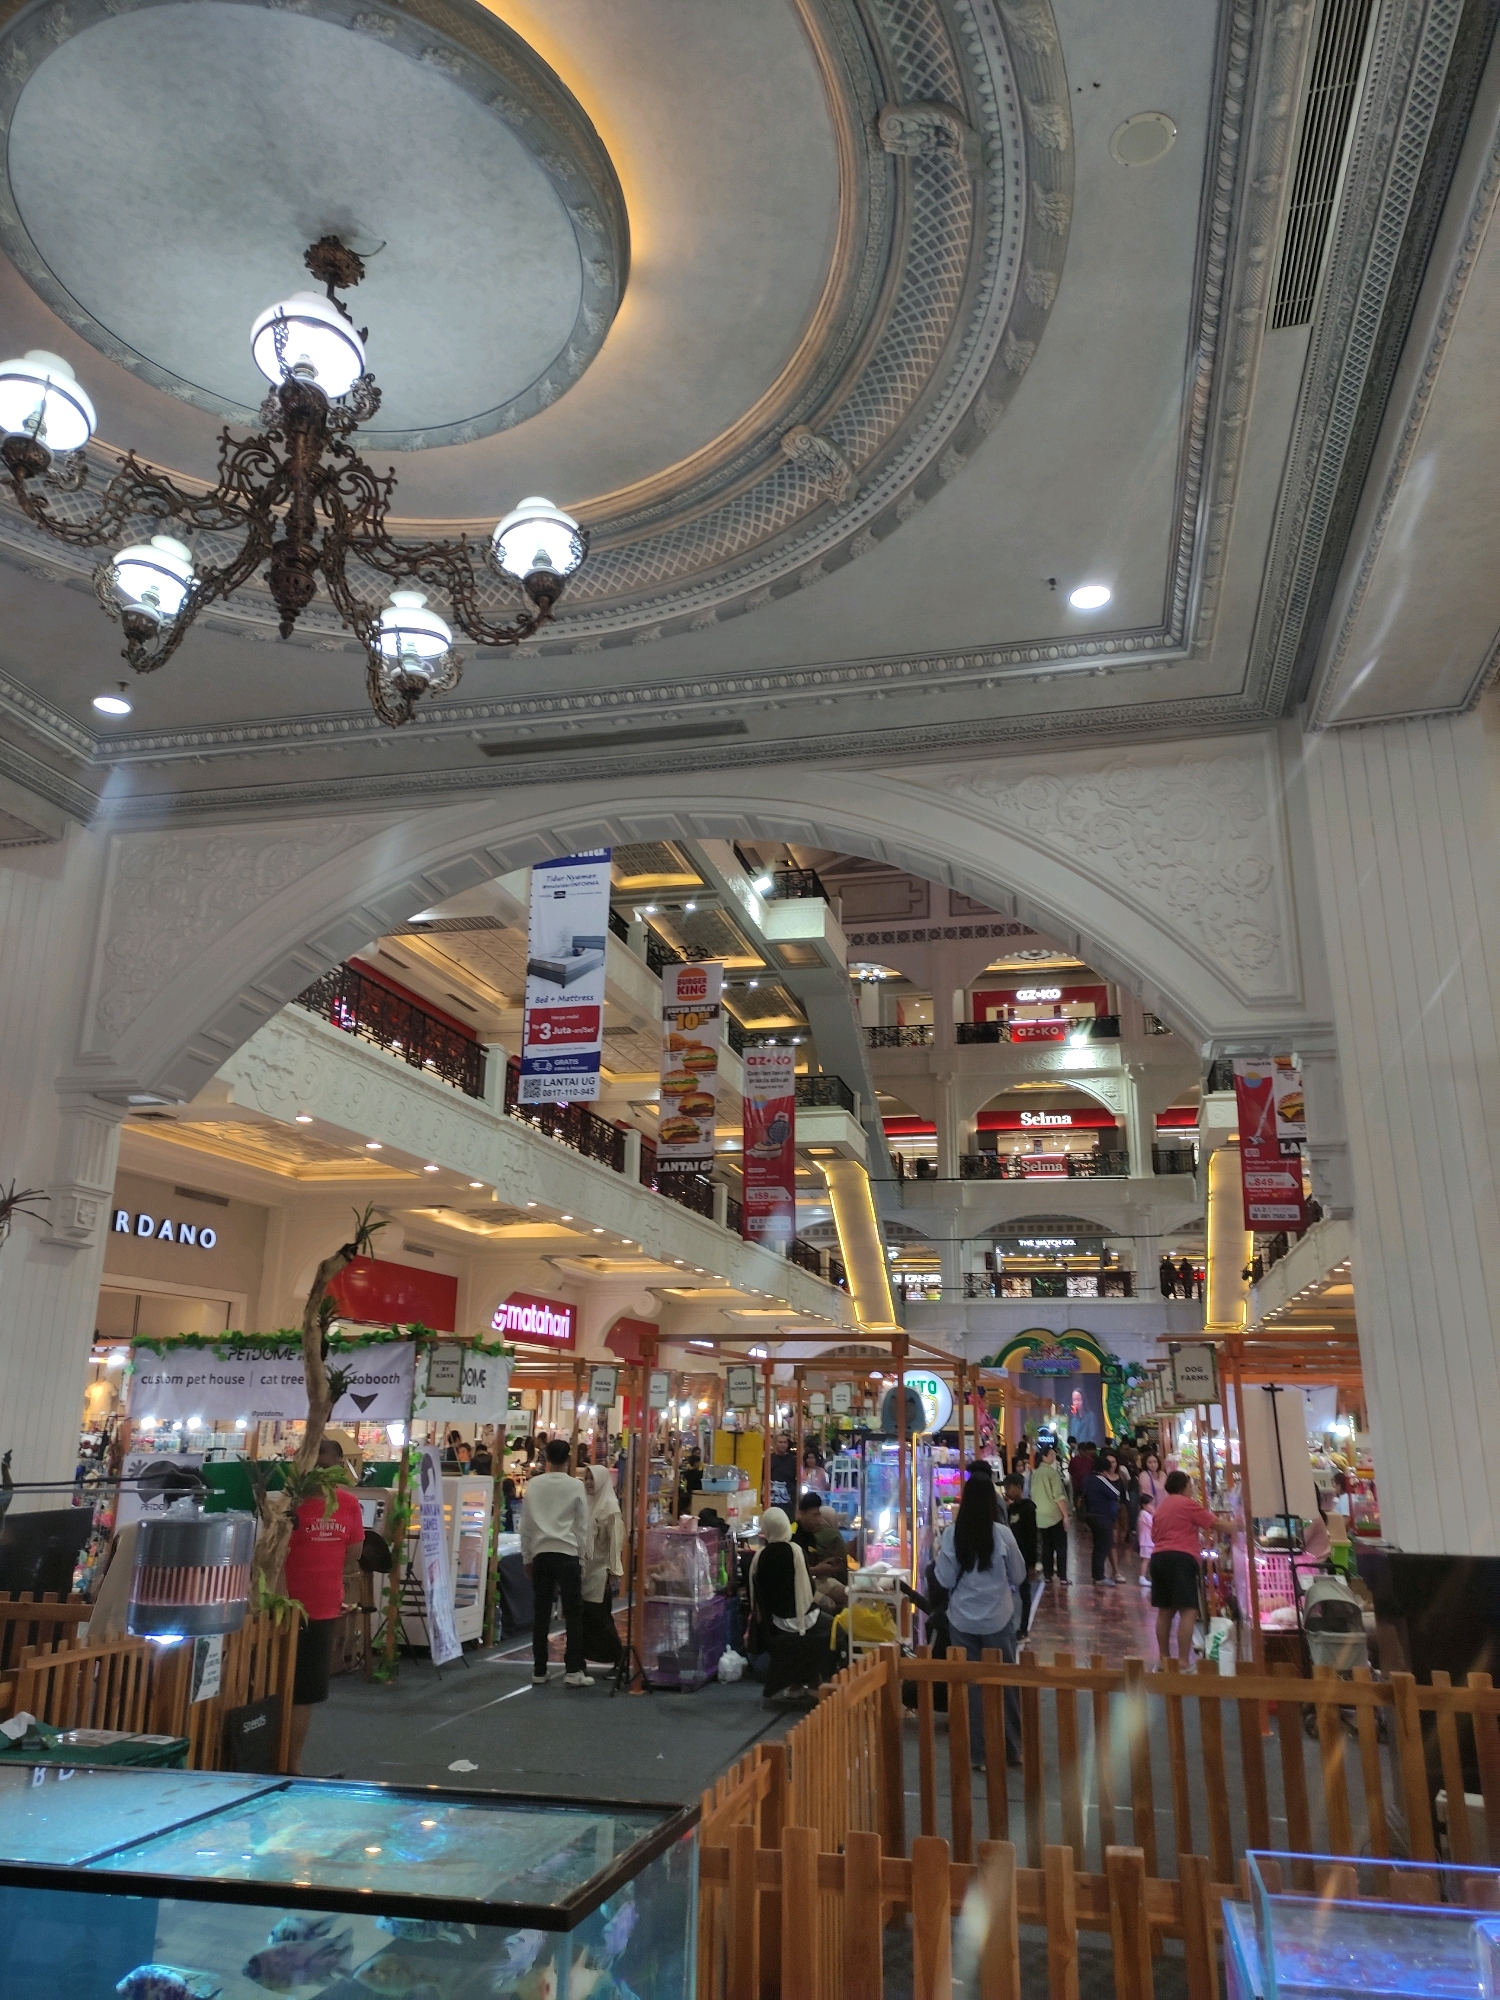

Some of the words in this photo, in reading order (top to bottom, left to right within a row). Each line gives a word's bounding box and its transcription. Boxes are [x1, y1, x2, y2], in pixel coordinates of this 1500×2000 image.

[546, 874, 564, 882] Tidur
[566, 873, 597, 882] Nyaman
[677, 985, 707, 995] KING
[535, 995, 549, 1003] Bed
[557, 994, 594, 1002] Mattress
[690, 1005, 716, 1013] HEMAT
[676, 1012, 699, 1031] 10
[539, 1022, 552, 1040] 3
[554, 1058, 579, 1066] GRATIS
[543, 1077, 579, 1087] LANTAI
[581, 1076, 595, 1085] UG
[542, 1087, 595, 1097] 0817-110-945
[1020, 1112, 1072, 1126] Selma
[657, 1161, 699, 1172] LANTAI
[700, 1160, 714, 1171] GF
[1021, 1161, 1064, 1172] Selma
[1254, 1178, 1274, 1186] 849
[754, 1192, 769, 1200] 159
[113, 1210, 217, 1249] RDANO
[506, 1303, 571, 1338] matahari
[228, 1346, 297, 1361] PETDOME
[141, 1374, 183, 1385] custom
[186, 1374, 206, 1387] pet
[209, 1373, 245, 1385] house
[260, 1375, 278, 1385] cat
[281, 1374, 304, 1385] tree
[344, 1373, 401, 1385] otobooth
[462, 1367, 487, 1389] DOME
[141, 1503, 165, 1511] PETDO
[423, 1517, 438, 1531] GAMES
